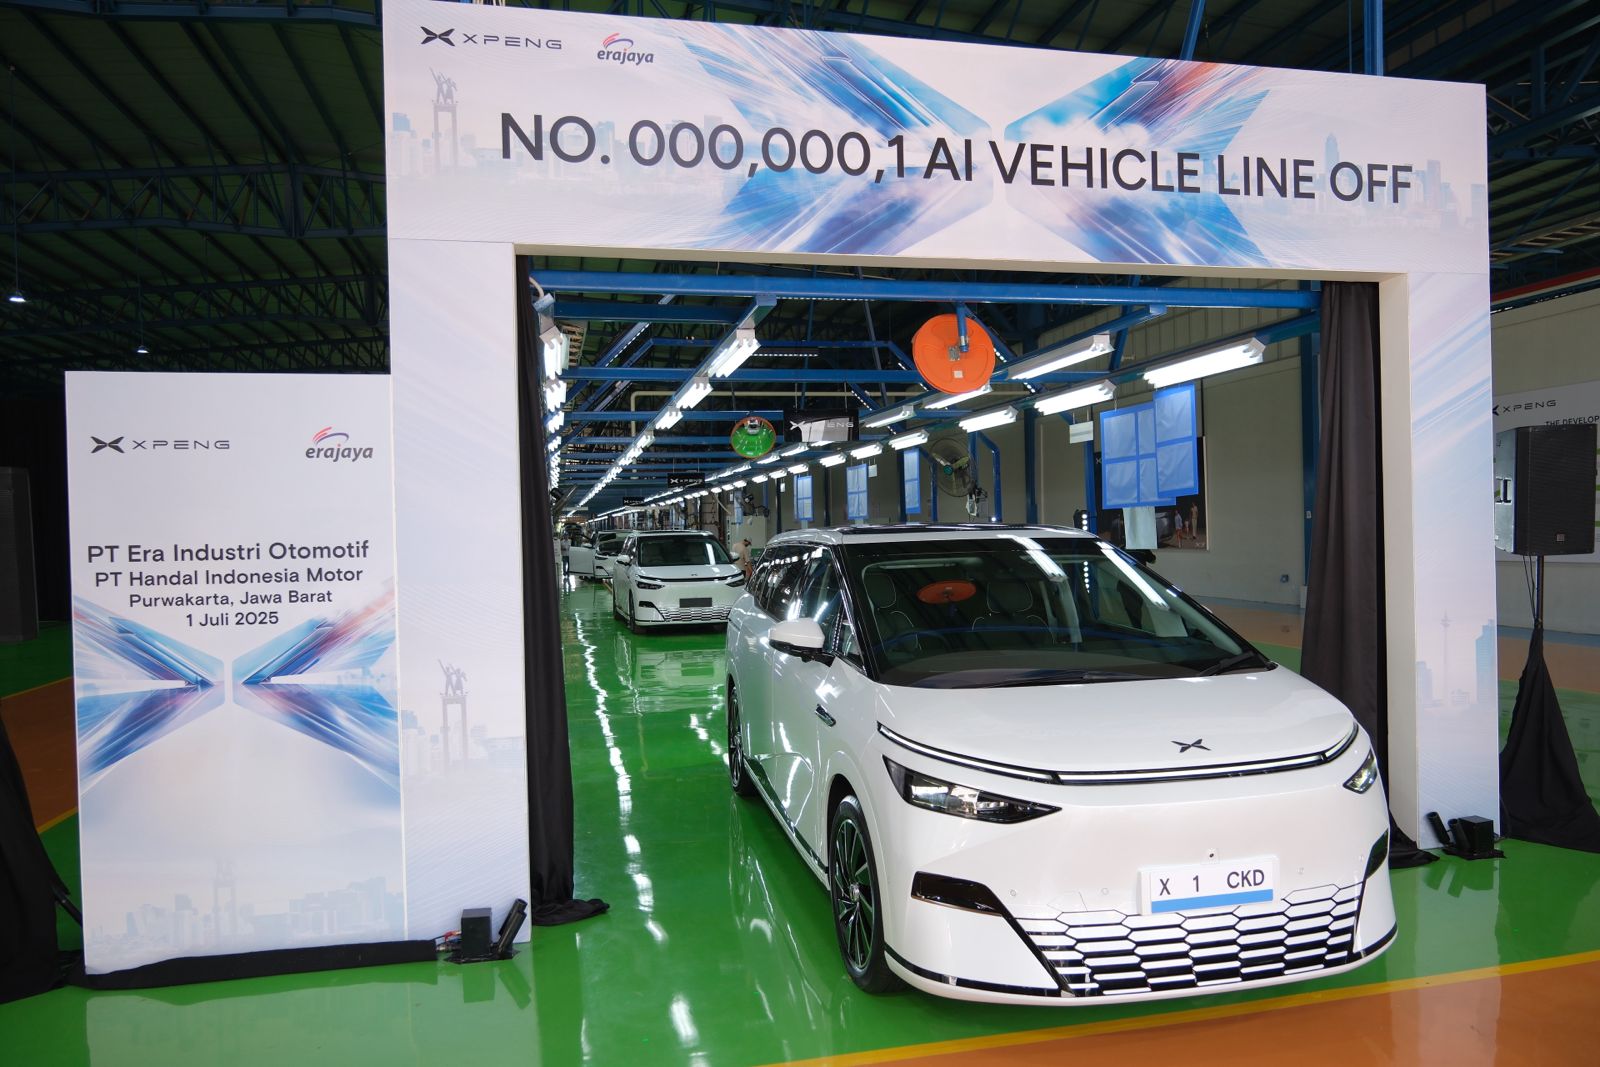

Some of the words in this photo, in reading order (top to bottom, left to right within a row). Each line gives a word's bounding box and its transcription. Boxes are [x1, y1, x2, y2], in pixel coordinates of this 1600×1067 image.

[464, 33, 562, 50] XPENG
[597, 46, 654, 66] erajaya
[501, 113, 610, 164] NO.
[629, 119, 905, 184] 000,000,1
[924, 138, 973, 182] AI
[989, 140, 1201, 194] VEHICLE
[1217, 154, 1315, 199] LINE
[1329, 161, 1413, 204] OFF
[1503, 400, 1557, 413] XPENG
[132, 440, 230, 450] XPENG
[305, 444, 374, 463] erajaya
[87, 545, 120, 563] PT
[128, 545, 165, 563] Era
[173, 543, 261, 562] Industri
[268, 540, 370, 560] Otomotif
[95, 572, 122, 587] PT
[129, 570, 198, 587] Handal
[205, 568, 300, 585] Indonesia
[306, 567, 364, 583] Motor
[129, 592, 234, 608] Purwakarta,
[239, 591, 283, 605] Jawa
[288, 589, 333, 604] Barat
[186, 614, 193, 627] 1
[199, 613, 229, 627] Juli
[235, 612, 279, 625] 2025
[1159, 878, 1171, 896] X
[1192, 875, 1199, 892] 1
[1227, 869, 1265, 889] CKD
